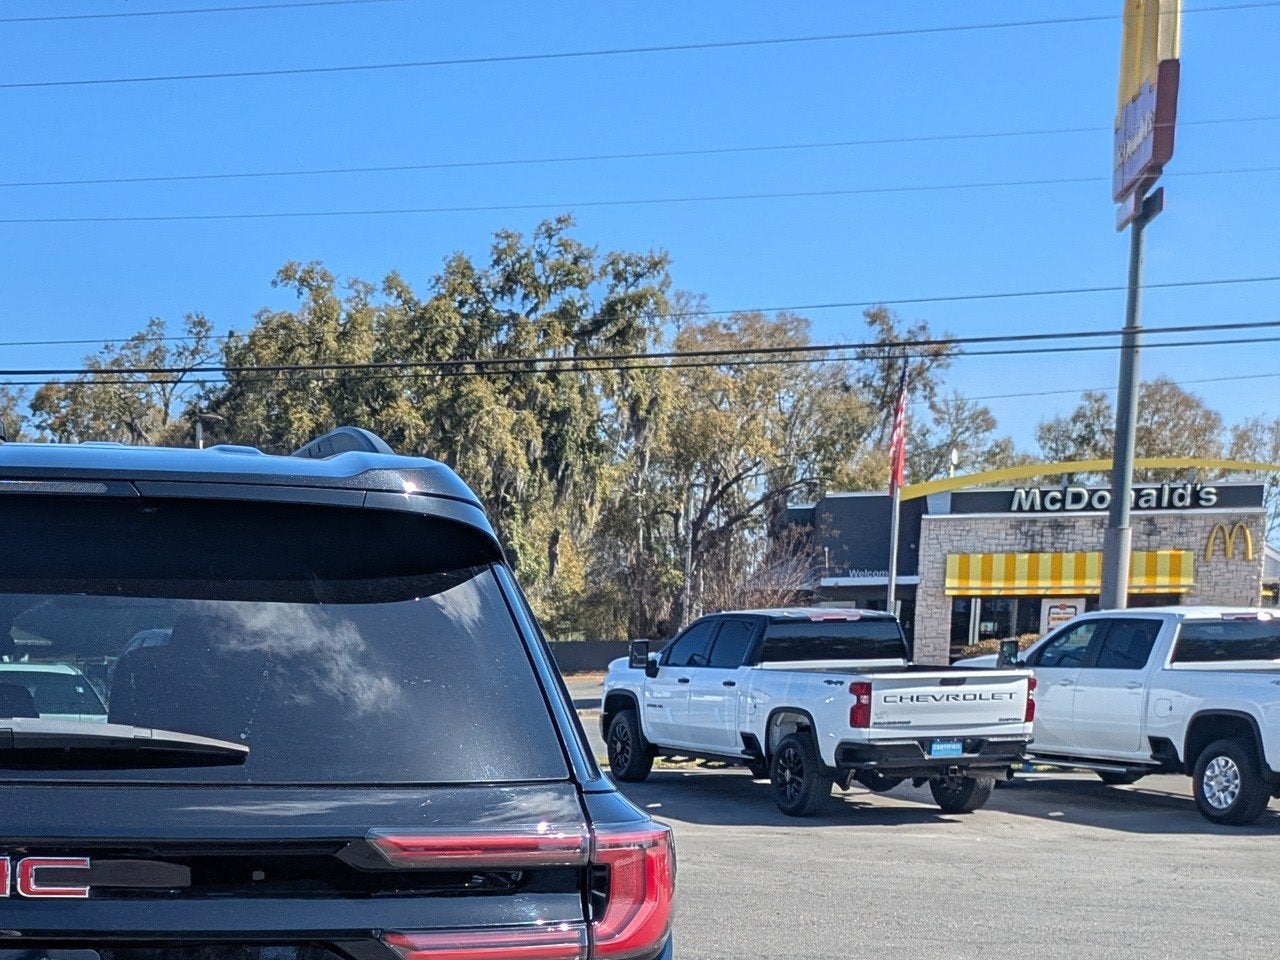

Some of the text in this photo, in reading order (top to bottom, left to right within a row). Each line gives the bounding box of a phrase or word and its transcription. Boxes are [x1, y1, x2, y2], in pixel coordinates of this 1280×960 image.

[1011, 484, 1218, 512] McDoald's
[848, 569, 889, 578] Welcom
[883, 692, 1018, 704] CHEVROLET
